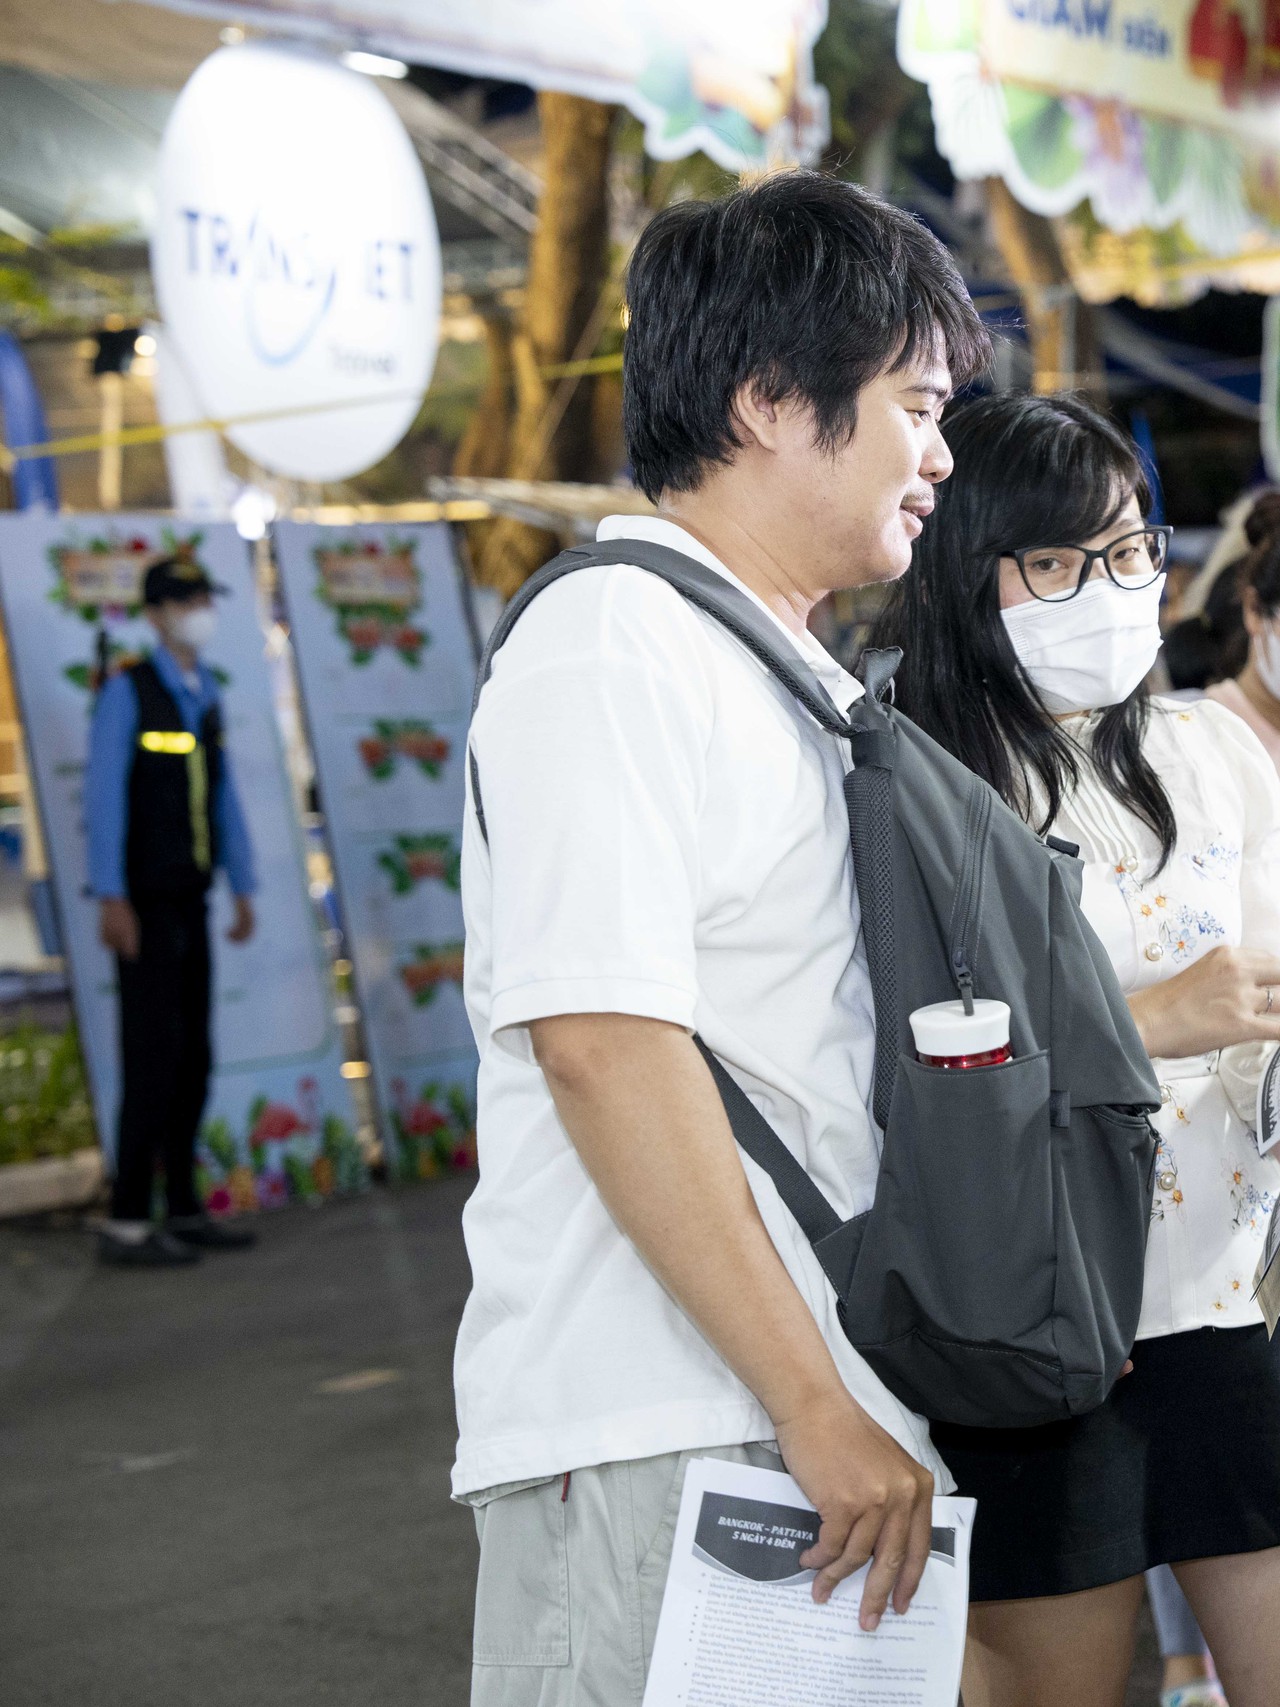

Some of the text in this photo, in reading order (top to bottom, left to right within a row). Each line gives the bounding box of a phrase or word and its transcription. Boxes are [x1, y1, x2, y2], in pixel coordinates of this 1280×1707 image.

[717, 1516, 764, 1532] BANGKOK
[771, 1525, 813, 1540] PATTAYA
[732, 1531, 740, 1540] 5
[740, 1532, 767, 1544] NGÀY
[766, 1537, 773, 1546] 4
